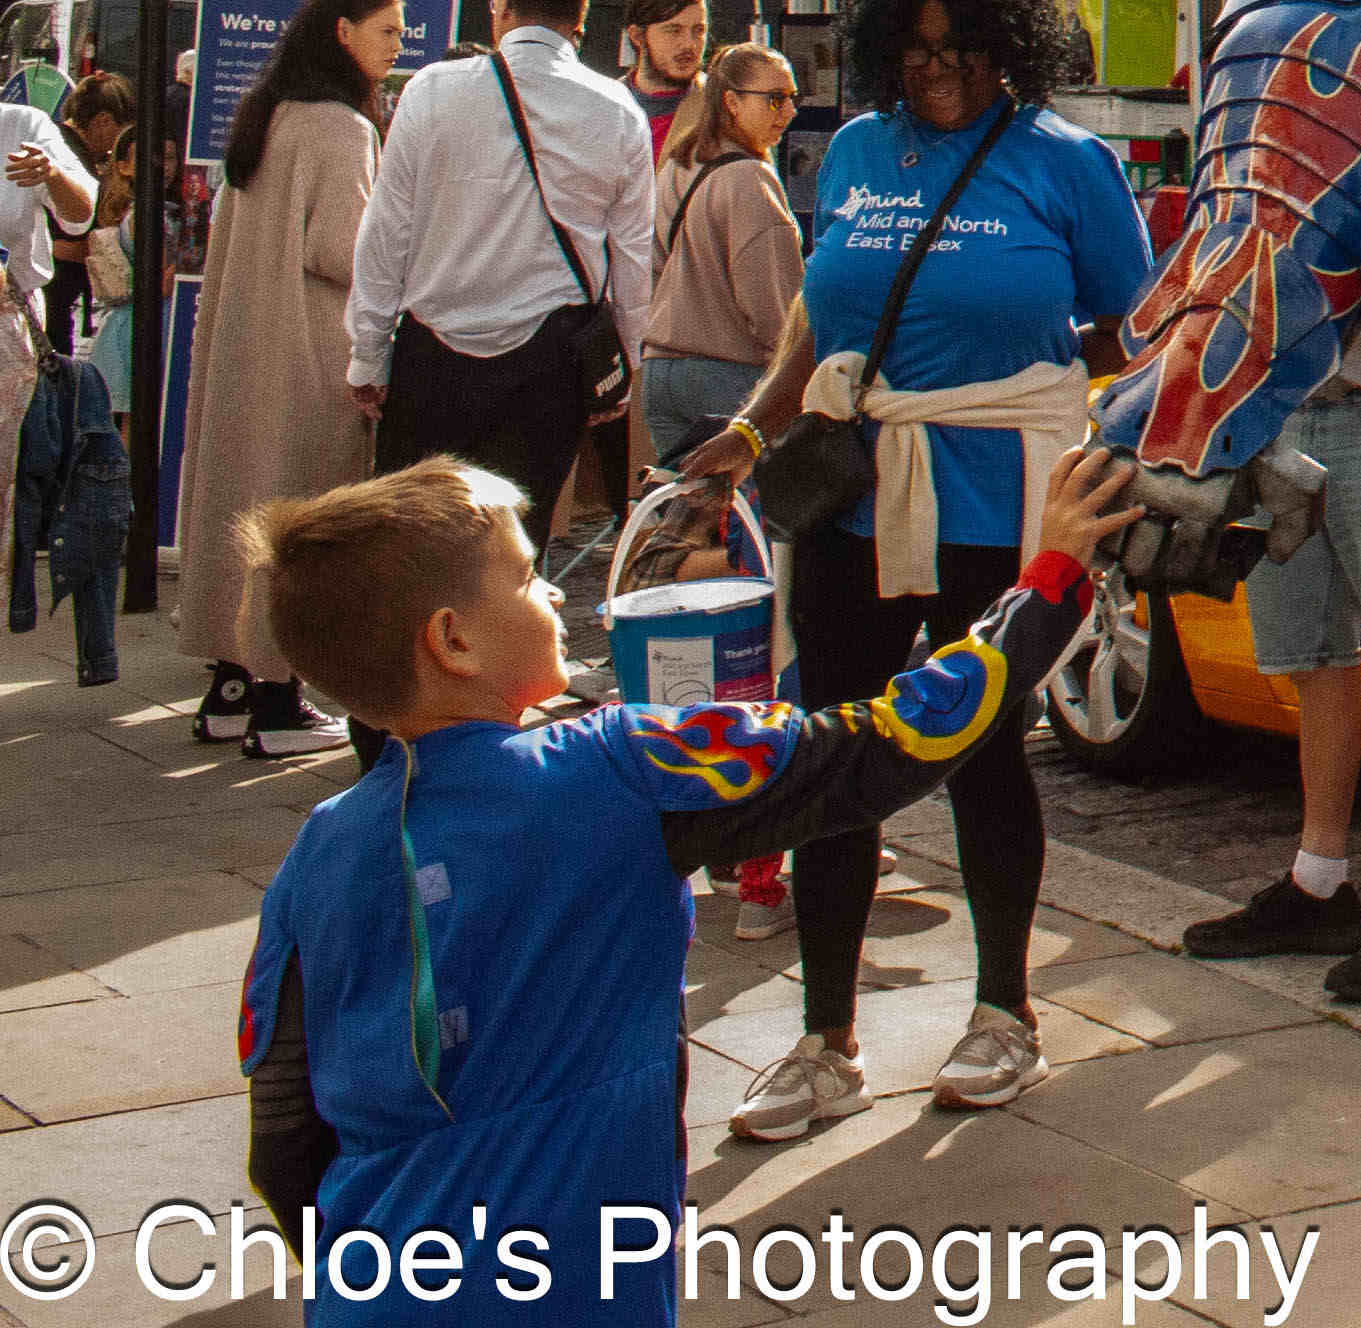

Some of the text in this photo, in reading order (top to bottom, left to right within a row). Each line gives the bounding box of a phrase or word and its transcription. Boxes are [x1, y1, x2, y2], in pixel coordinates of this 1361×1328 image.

[220, 12, 277, 32] We're
[864, 188, 925, 210] mind
[855, 211, 896, 230] Mid
[942, 213, 1009, 237] North
[845, 231, 964, 252] East Esex
